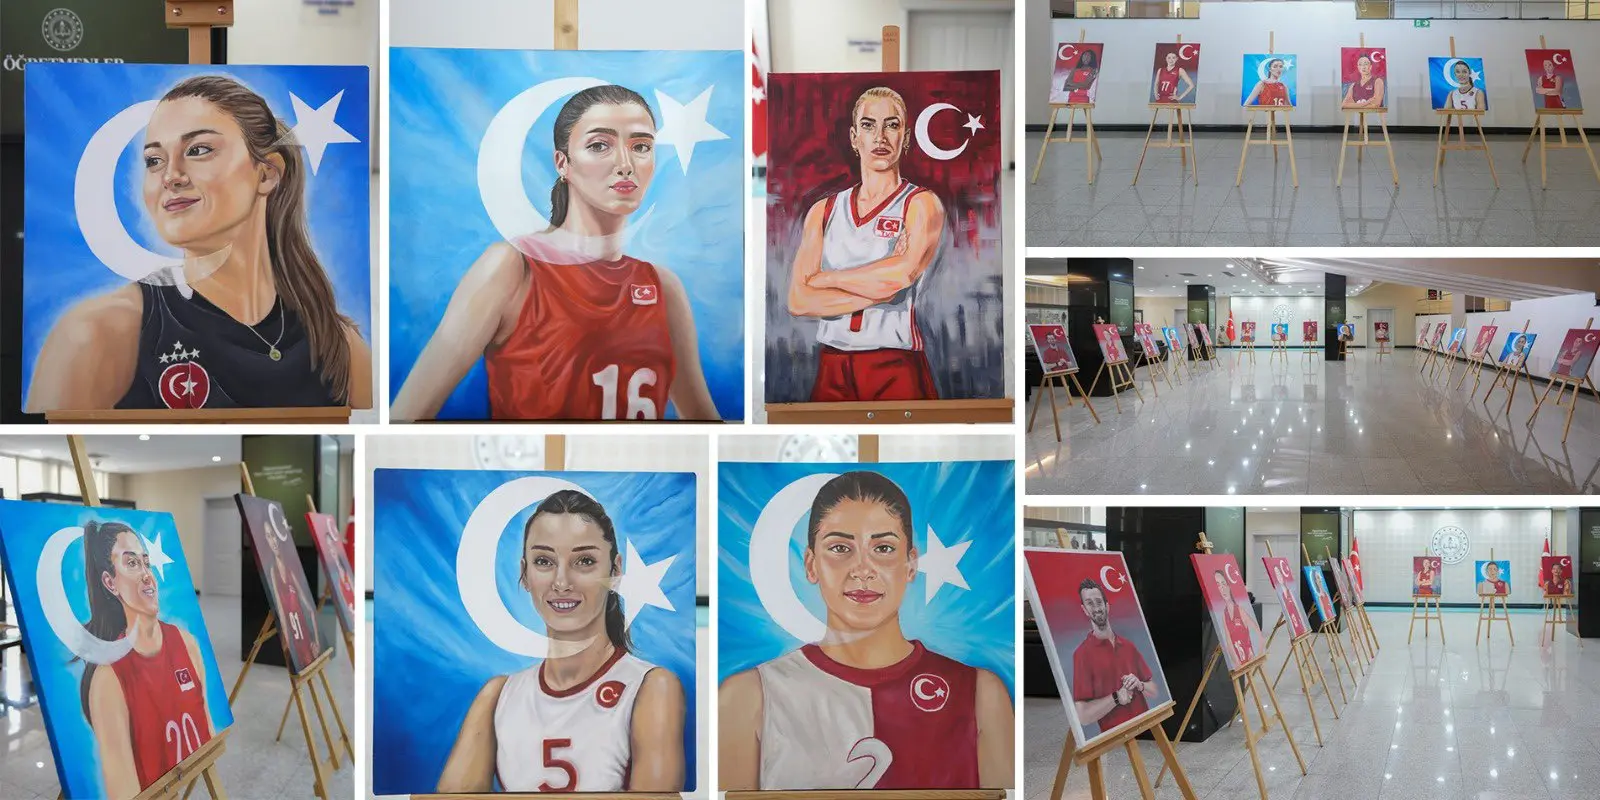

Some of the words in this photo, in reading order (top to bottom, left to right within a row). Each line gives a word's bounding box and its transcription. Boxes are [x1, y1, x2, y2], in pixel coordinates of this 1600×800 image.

[1460, 100, 1468, 109] 5
[592, 364, 658, 420] 16
[288, 611, 304, 640] 91
[165, 712, 202, 764] 20
[847, 736, 893, 789] 2
[537, 738, 578, 792] 5
